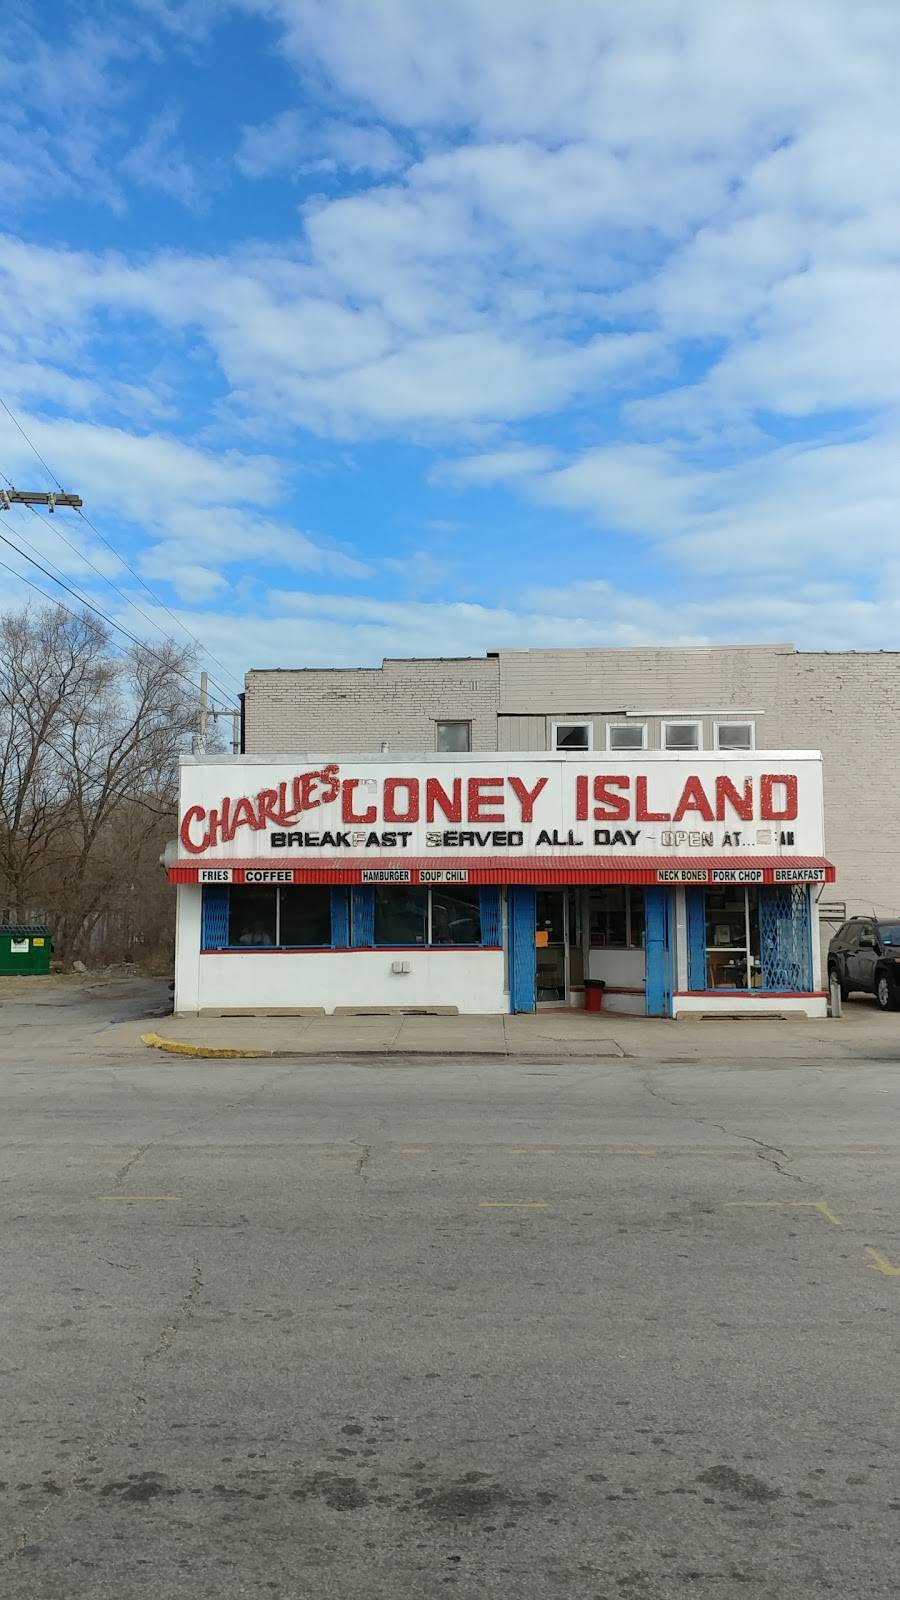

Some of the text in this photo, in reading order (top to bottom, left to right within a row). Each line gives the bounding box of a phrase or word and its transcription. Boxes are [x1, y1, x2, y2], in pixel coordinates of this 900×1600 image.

[341, 776, 549, 824] CONEY
[575, 774, 799, 823] ISLAND
[270, 830, 413, 848] BREAKFAST
[425, 830, 524, 848] SERVED
[535, 829, 583, 847] ALL
[593, 829, 642, 847] DAY
[661, 830, 714, 848] OPEN
[202, 869, 229, 881] FRIES
[245, 871, 293, 881] COFFEE
[363, 871, 409, 881] HAMBURGER
[445, 871, 467, 881] CHILI
[658, 870, 707, 881] NECK BONES
[713, 870, 762, 881] PORK CHOP
[775, 869, 824, 881] BREAKFAST
